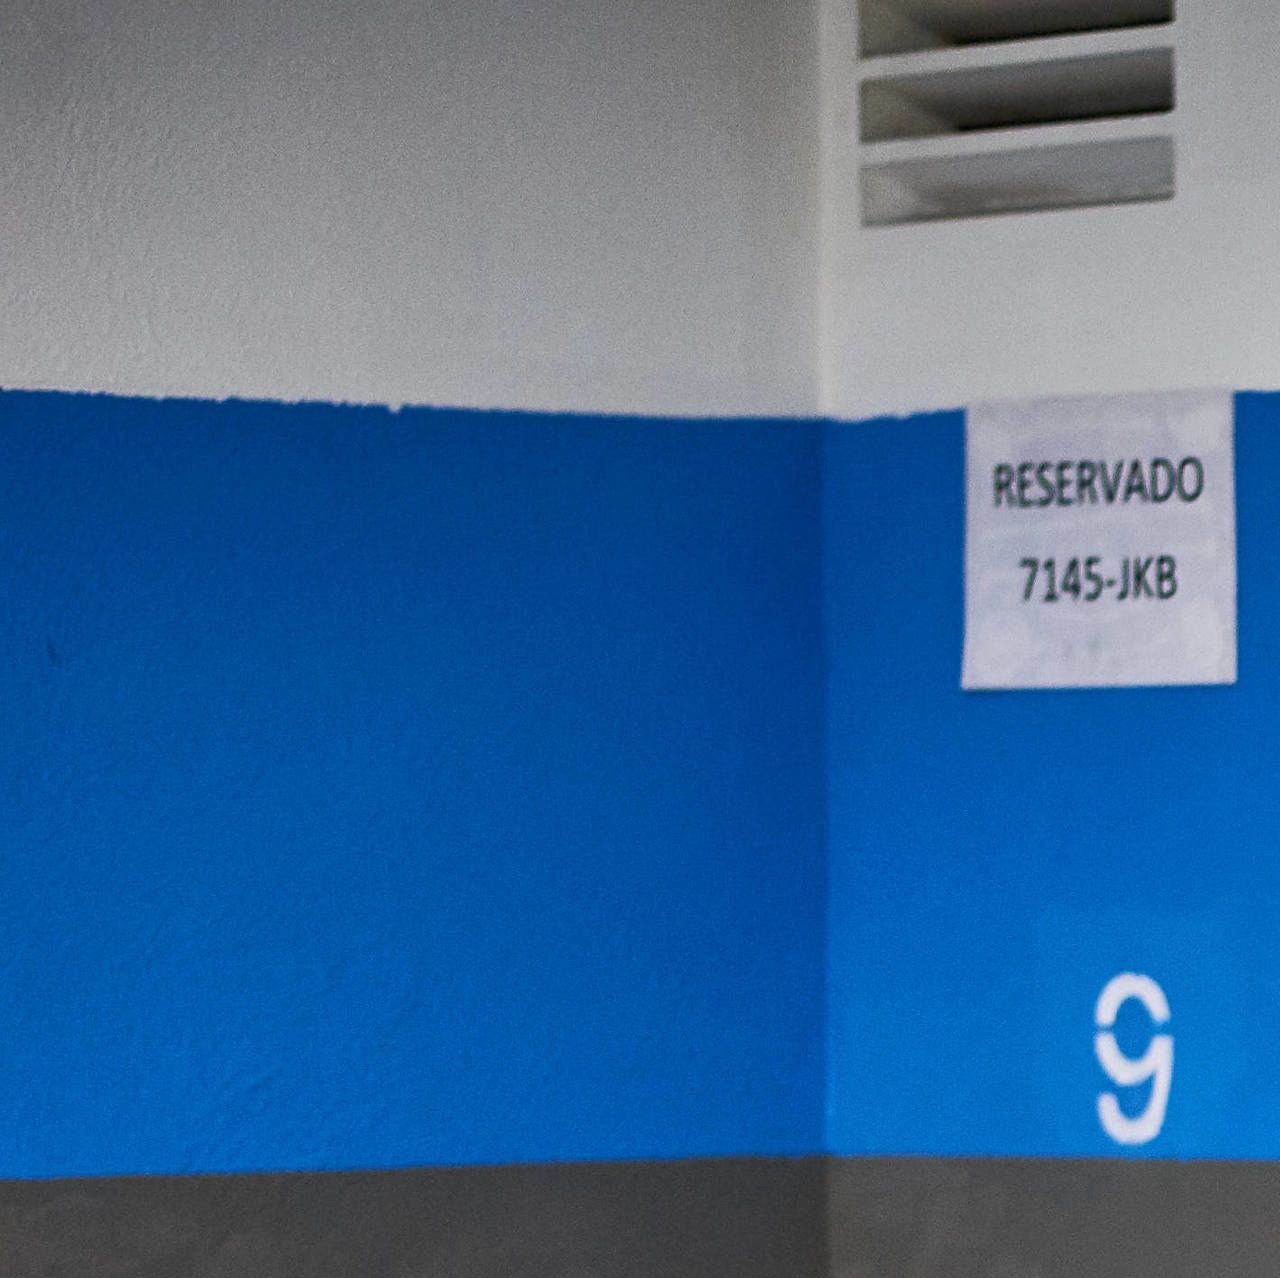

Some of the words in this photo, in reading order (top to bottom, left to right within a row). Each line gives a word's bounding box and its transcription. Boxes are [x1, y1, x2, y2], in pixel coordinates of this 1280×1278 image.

[992, 455, 1206, 508] RESERVADO
[1018, 553, 1179, 603] 7145-JKB
[1094, 971, 1174, 1145] 9
